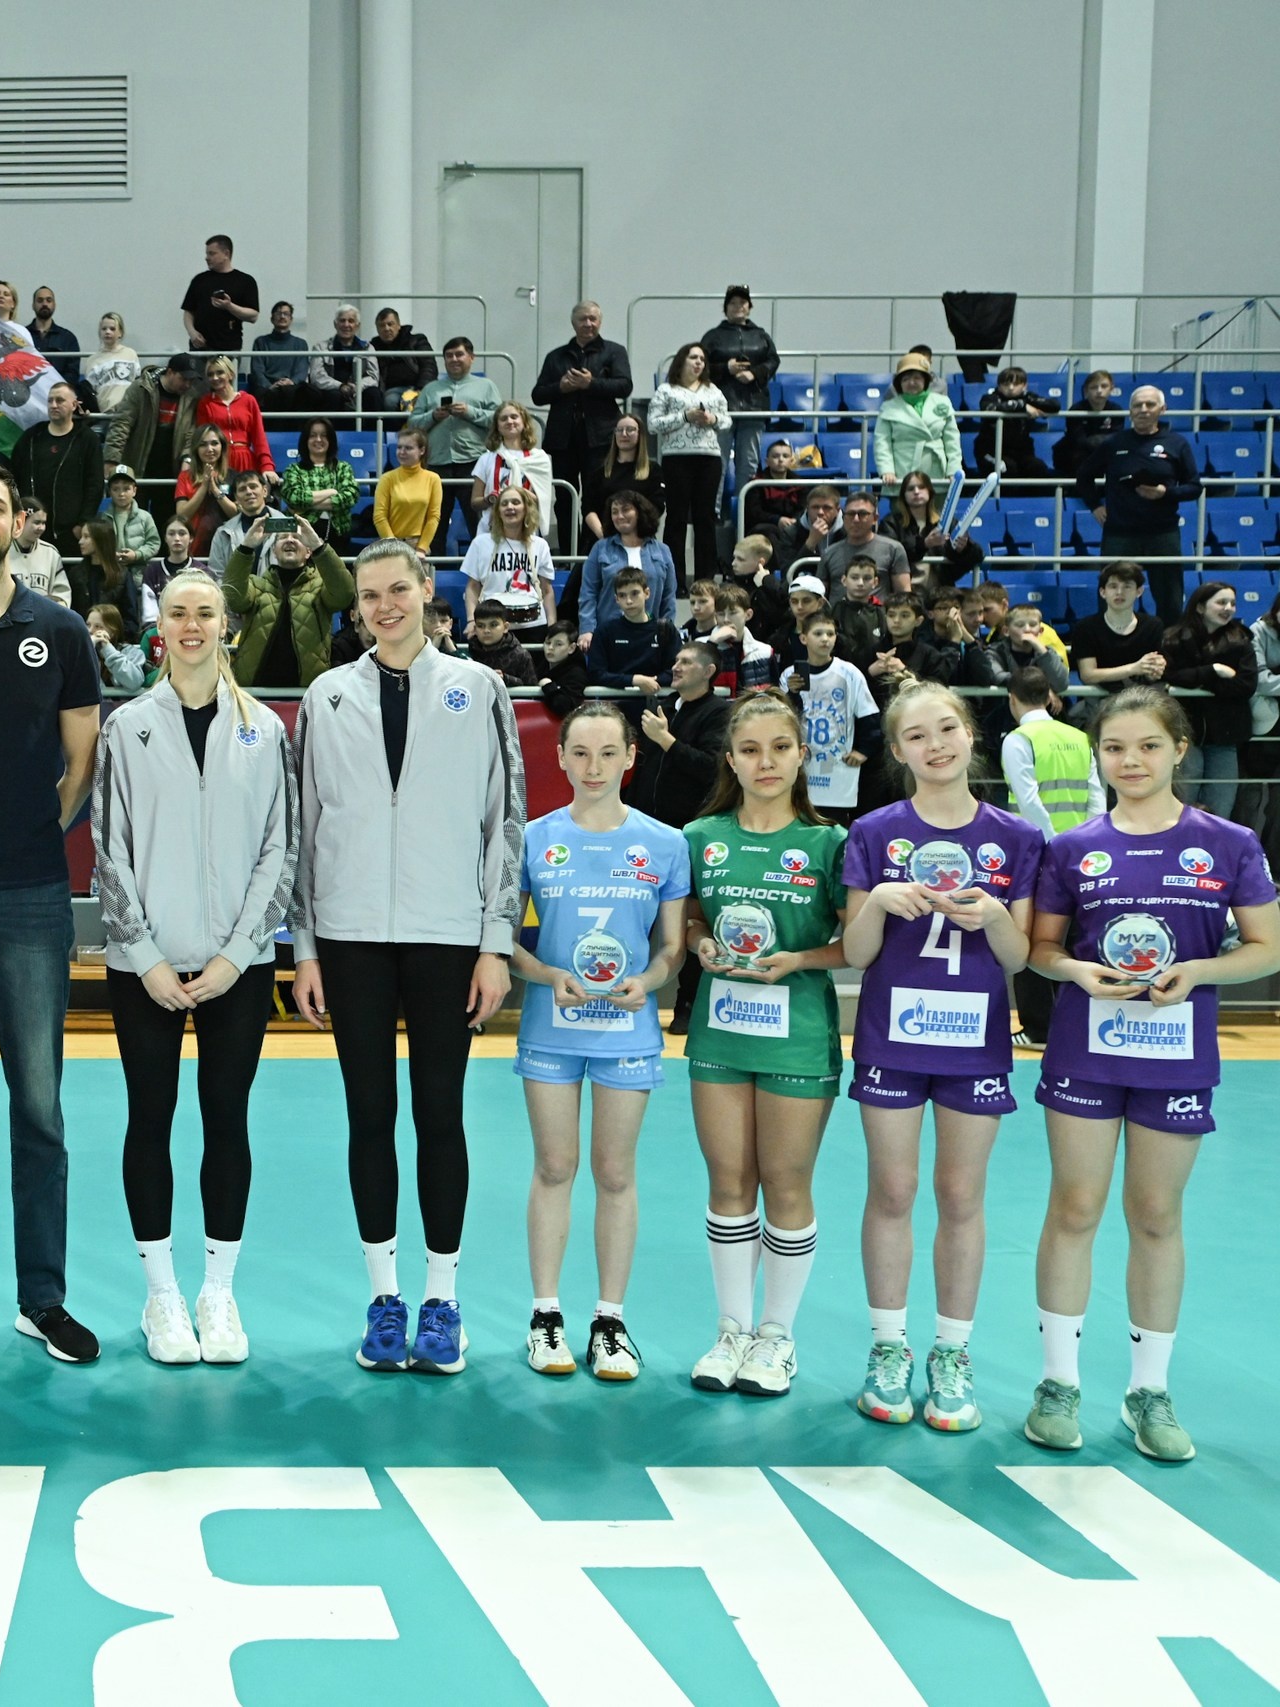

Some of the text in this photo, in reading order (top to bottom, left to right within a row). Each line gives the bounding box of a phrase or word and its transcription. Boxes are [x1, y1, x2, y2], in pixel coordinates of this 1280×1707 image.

[558, 869, 576, 878] РТ
[612, 870, 658, 883] ШВЛ ПРО
[712, 869, 730, 878] РТ
[765, 873, 815, 886] ШВЛ ПРО
[1098, 877, 1120, 888] РТ
[1165, 876, 1196, 887] ШВЛ
[540, 886, 564, 899] СШ
[717, 885, 812, 904] «ЮНОСТЬ»
[577, 907, 615, 940] 7
[919, 911, 962, 976] 4
[1119, 933, 1156, 943] MVP
[733, 999, 781, 1016] ГАЗПРОМ
[925, 1010, 980, 1025] ГАЗПРОМ
[926, 1024, 980, 1034] ТРАНСГАЗ
[1127, 1020, 1186, 1036] ГАЗПРОМ
[1127, 1035, 1186, 1045] ТРАНСГАЗ
[1127, 1043, 1186, 1052] КАЗАНЬ
[868, 1066, 882, 1084] 4
[863, 1084, 908, 1097] славица
[974, 1094, 1007, 1103] ТЕХНО
[1053, 1089, 1103, 1106] славица
[1166, 1113, 1203, 1121] ТЕХНО
